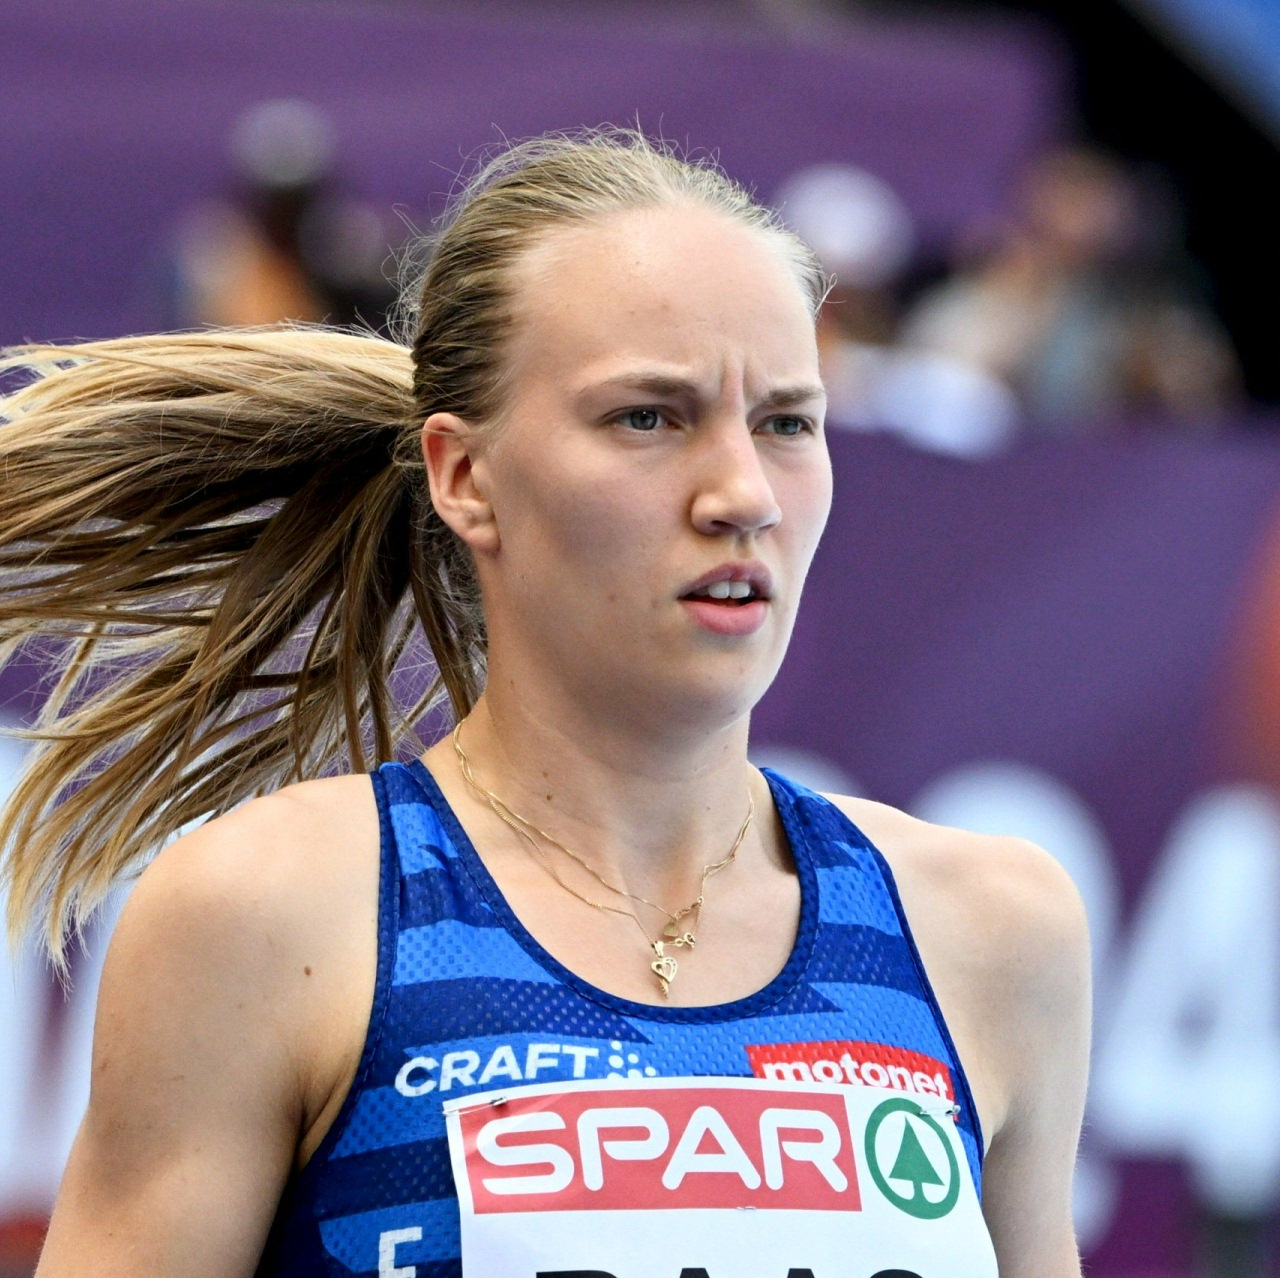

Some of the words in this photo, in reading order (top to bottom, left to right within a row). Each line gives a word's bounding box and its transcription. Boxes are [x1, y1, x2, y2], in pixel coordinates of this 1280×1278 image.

[395, 1044, 599, 1097] CRAFT
[762, 1053, 949, 1100] motonet
[476, 1106, 848, 1195] SPAR
